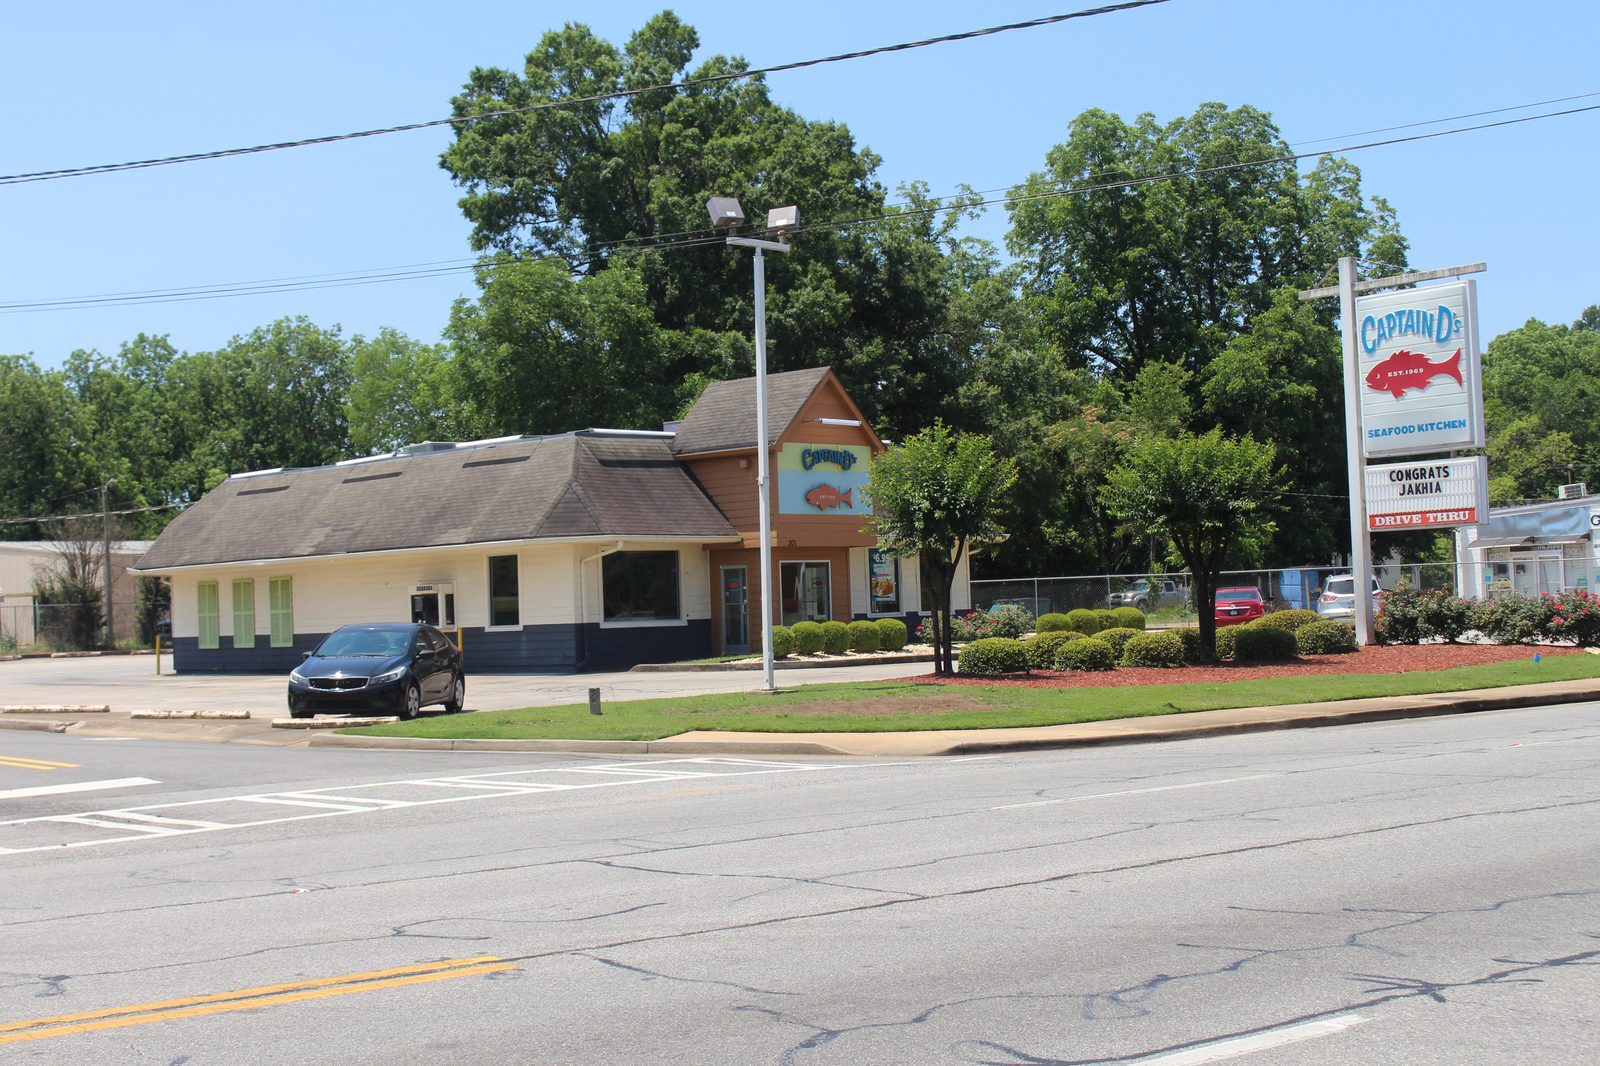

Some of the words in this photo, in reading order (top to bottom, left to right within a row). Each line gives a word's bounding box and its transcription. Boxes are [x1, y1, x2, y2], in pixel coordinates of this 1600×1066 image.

[1361, 309, 1434, 353] CAPTAIN
[1367, 424, 1416, 438] SEAFOOD
[1417, 419, 1467, 433] KITCHEN
[1389, 465, 1450, 482] CONGRATS
[1399, 481, 1442, 496] JAKHIA
[1374, 513, 1422, 527] DRIVE
[1426, 510, 1470, 523] THRU
